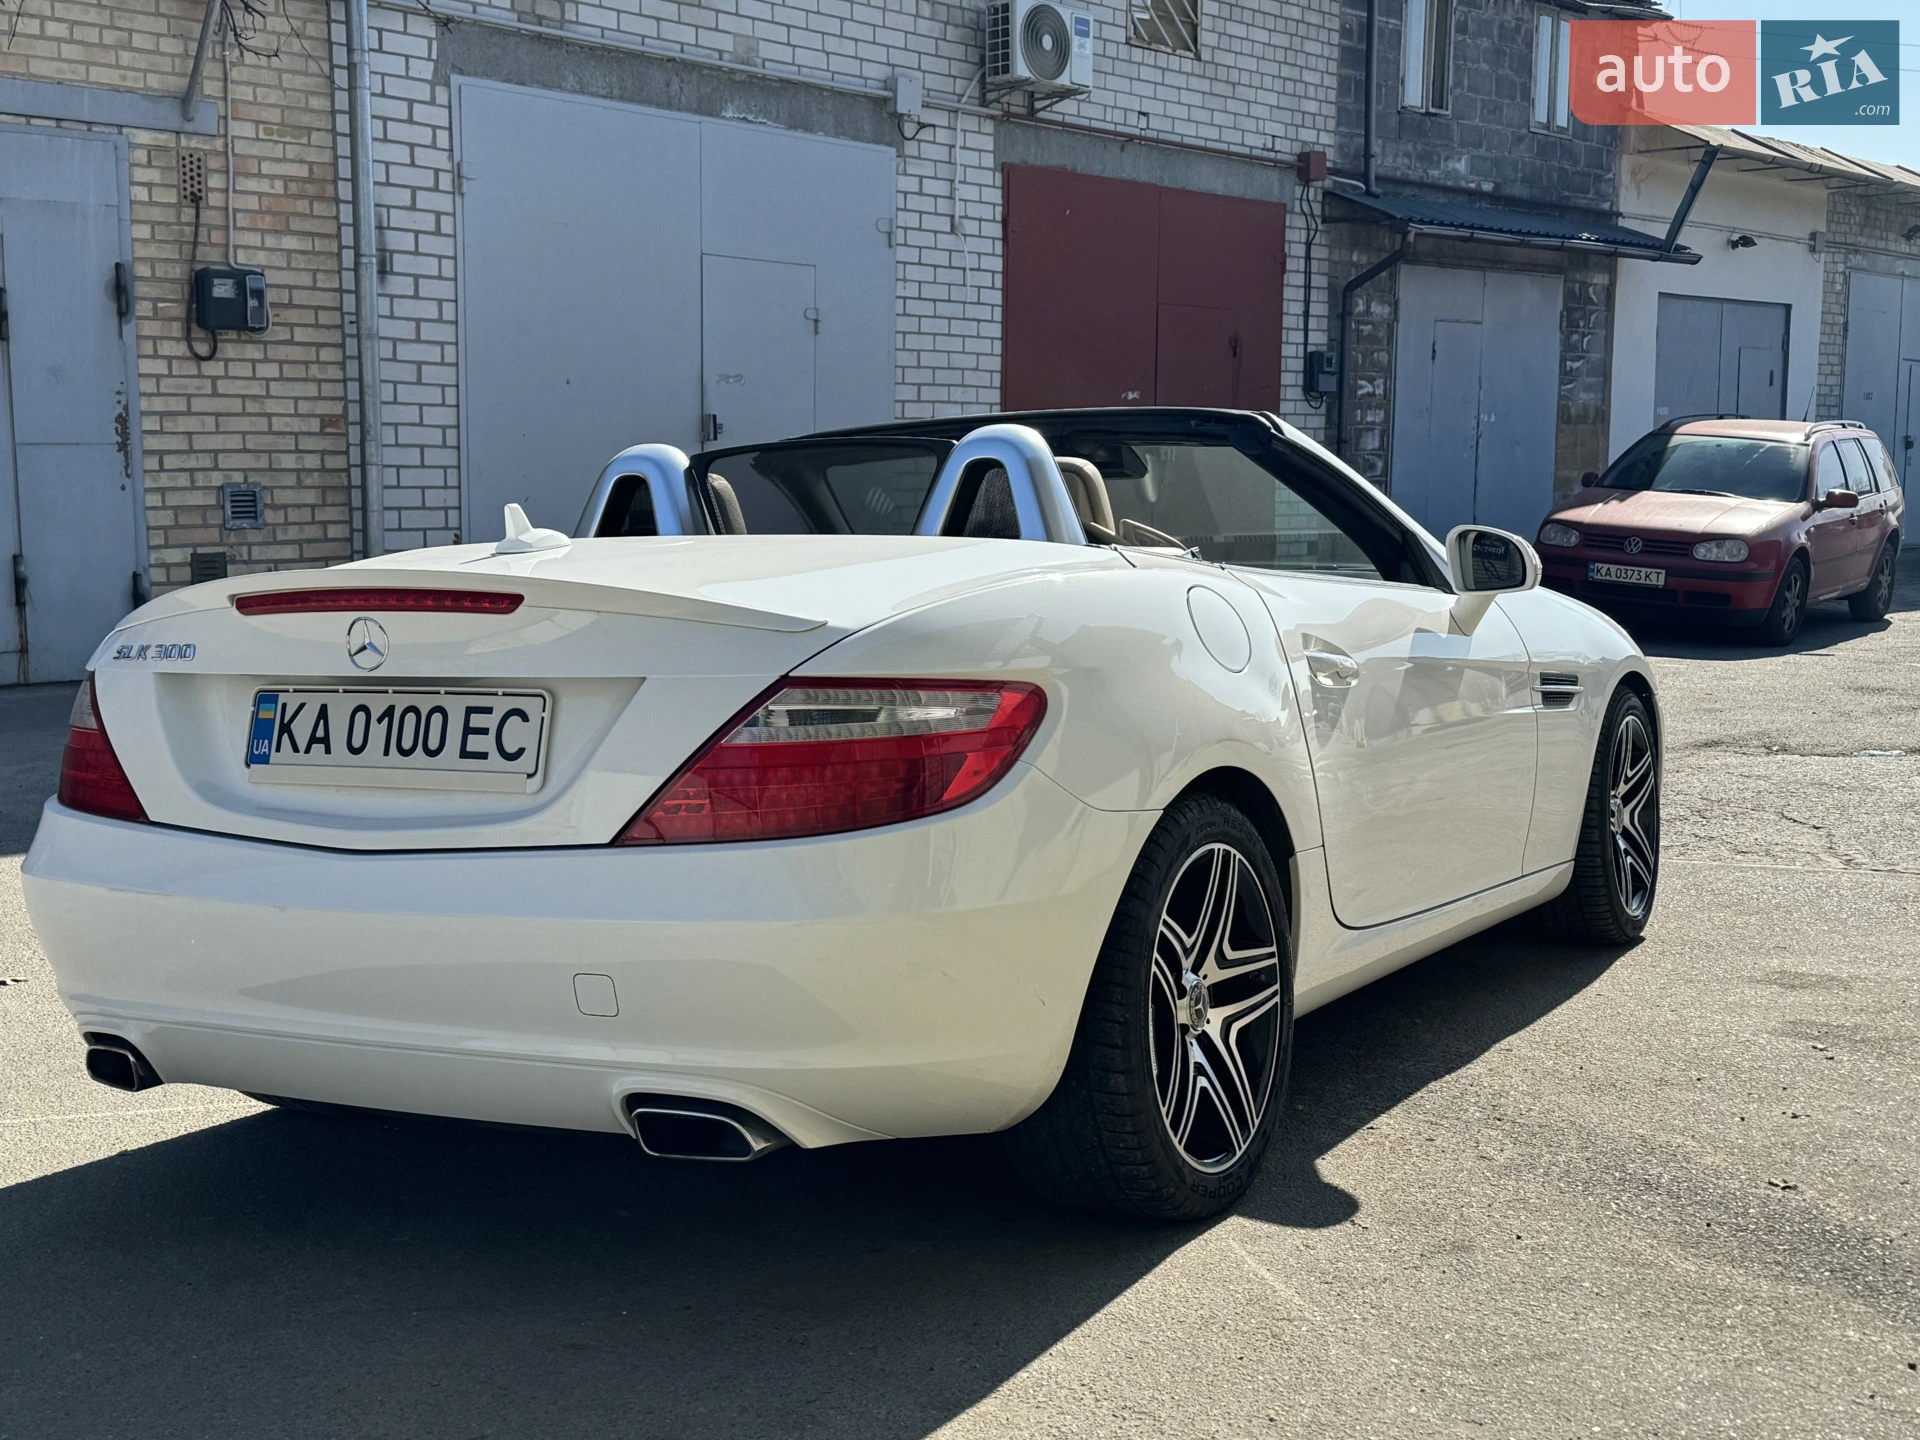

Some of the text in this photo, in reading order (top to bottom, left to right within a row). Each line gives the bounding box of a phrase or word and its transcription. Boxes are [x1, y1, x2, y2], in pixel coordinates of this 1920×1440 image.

[1595, 565, 1663, 583] KA 0373 KT
[112, 643, 196, 661] SLK 300
[275, 702, 530, 762] KA 0100 EC
[253, 739, 270, 755] UA
[1191, 1175, 1244, 1199] COOPER
